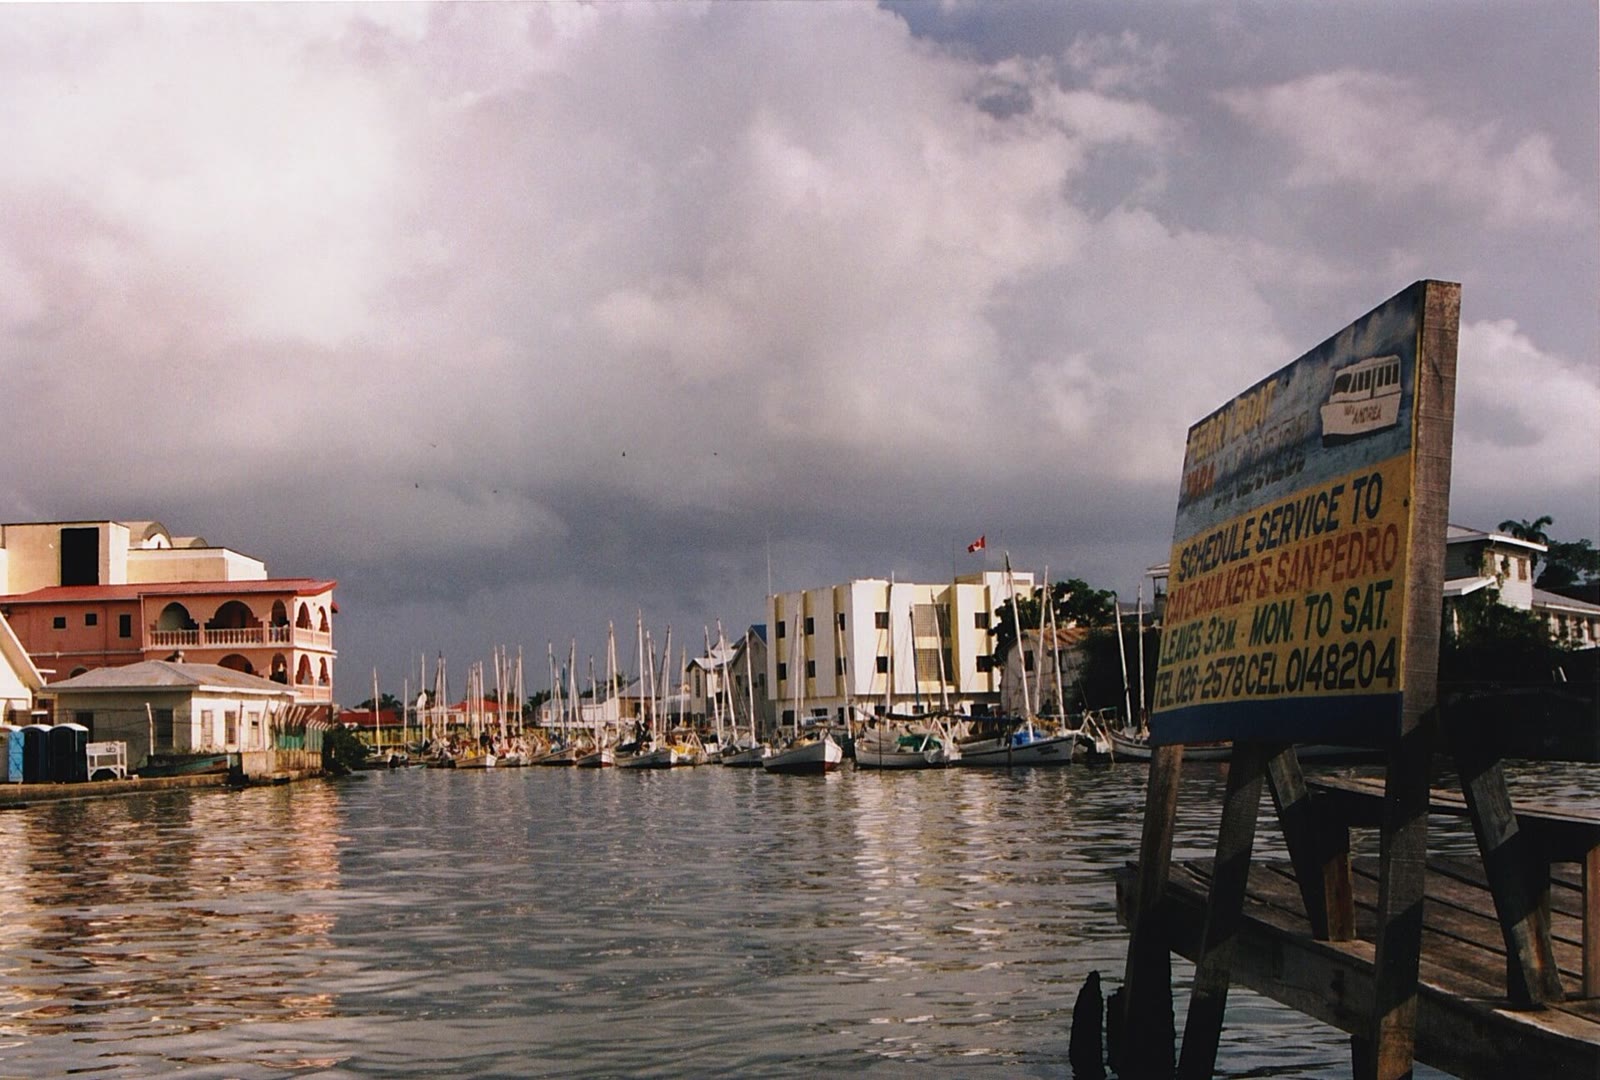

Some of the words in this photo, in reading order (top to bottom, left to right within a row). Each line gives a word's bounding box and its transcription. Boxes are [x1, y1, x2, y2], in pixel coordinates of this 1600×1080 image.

[1177, 517, 1256, 582] SCHEDULE
[1256, 485, 1345, 552] SERVICE
[1352, 472, 1383, 525] TO
[1317, 523, 1398, 585] PEDRO
[1160, 620, 1204, 666] LEAVES
[1304, 592, 1333, 640] TO
